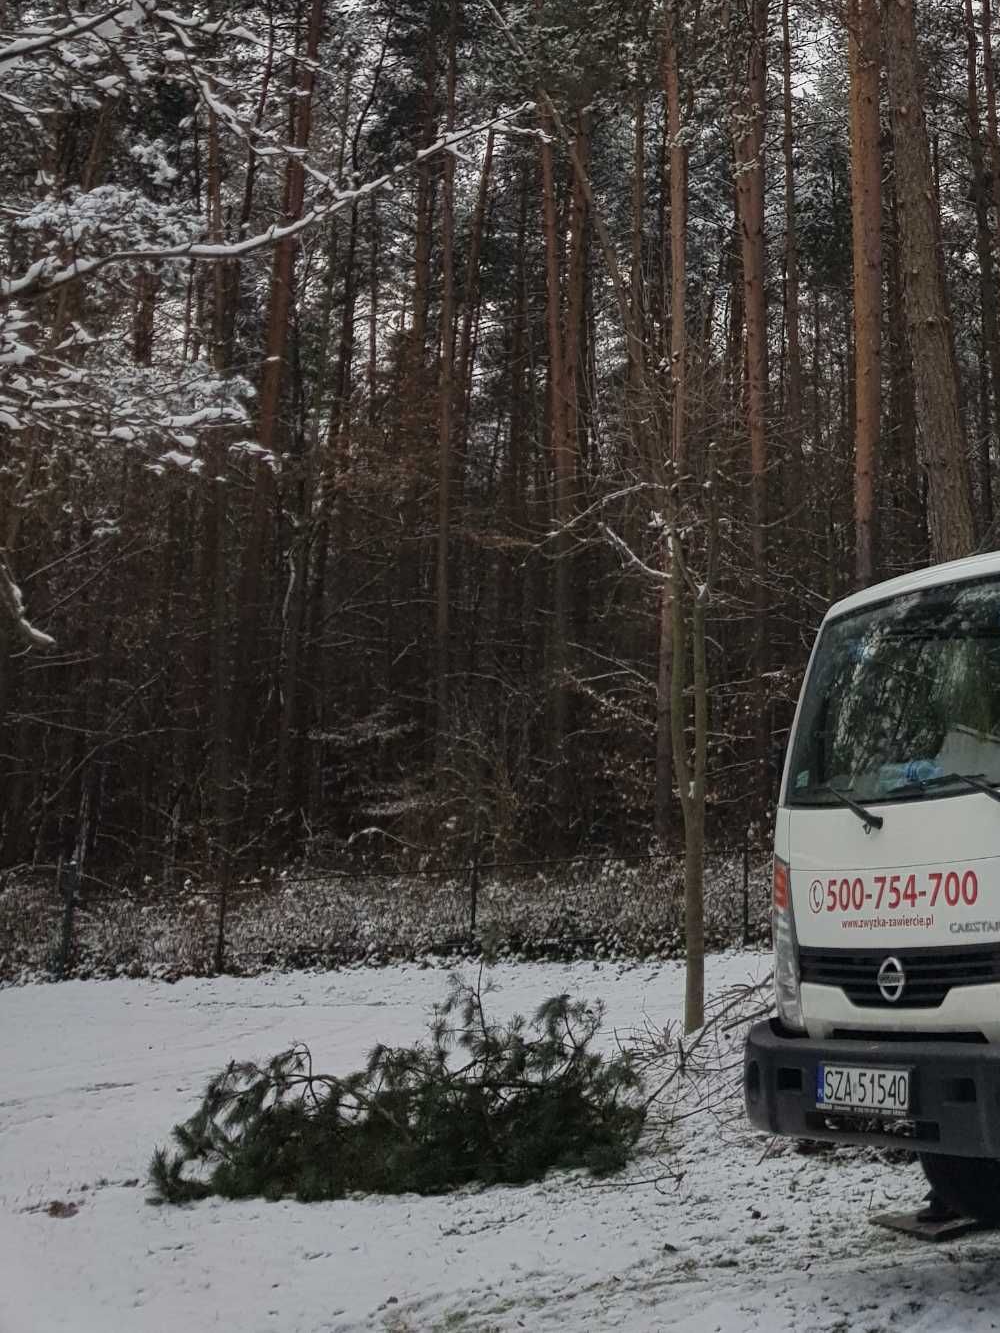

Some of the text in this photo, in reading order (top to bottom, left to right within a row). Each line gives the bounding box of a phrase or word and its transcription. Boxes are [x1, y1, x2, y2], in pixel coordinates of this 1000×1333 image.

[826, 870, 978, 912] 500-754-700
[842, 915, 934, 930] www.zwyzka-zawiercie.pl
[825, 1070, 907, 1106] SZA 51540
